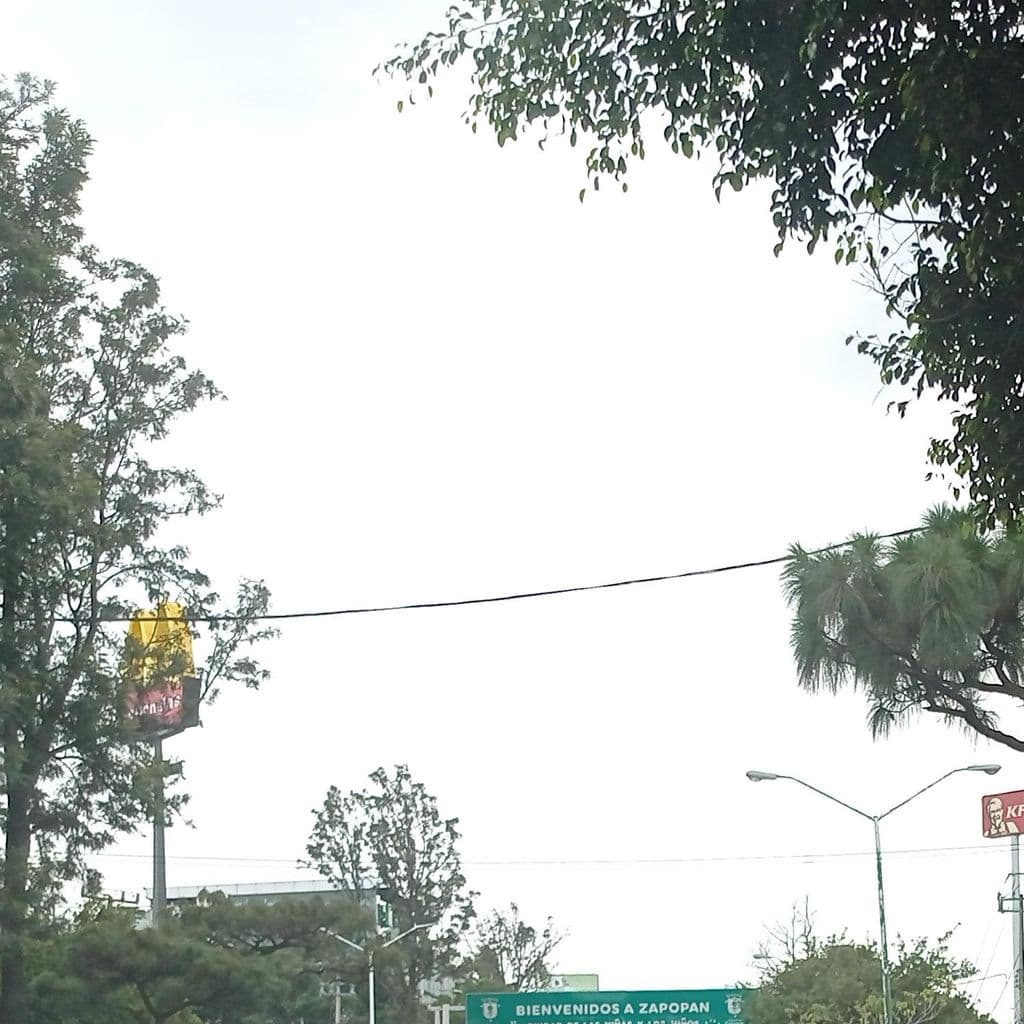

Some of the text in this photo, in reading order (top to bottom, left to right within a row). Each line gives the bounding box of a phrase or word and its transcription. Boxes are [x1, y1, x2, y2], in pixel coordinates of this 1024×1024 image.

[515, 1001, 710, 1016] BIENVENIDOS A ZAPOPAN
